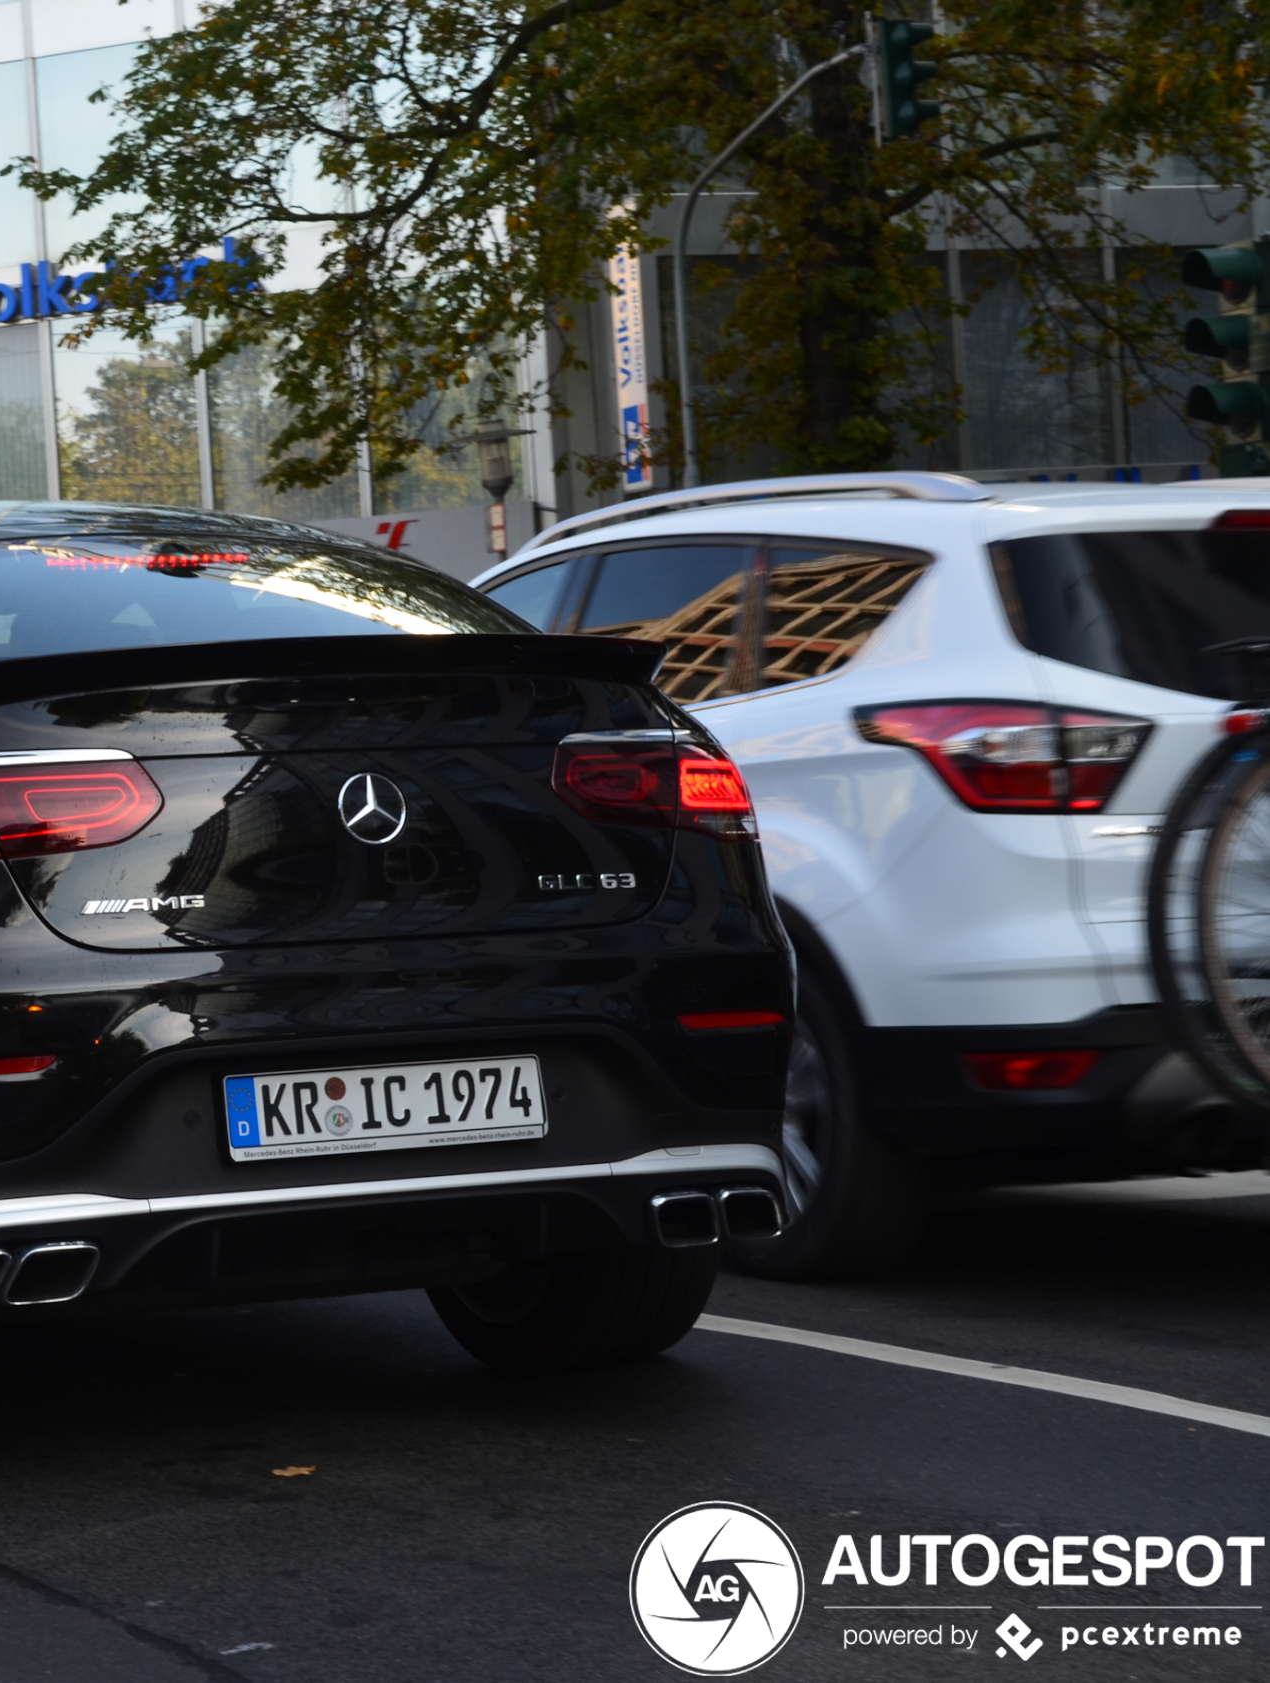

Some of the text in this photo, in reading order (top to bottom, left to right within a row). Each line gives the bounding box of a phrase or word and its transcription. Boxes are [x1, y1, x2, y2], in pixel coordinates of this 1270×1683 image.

[538, 872, 636, 890] GLC 63
[121, 894, 205, 912] AMG
[261, 1081, 322, 1137] KR
[360, 1075, 411, 1130] IC
[424, 1066, 532, 1125] 1974
[238, 1120, 250, 1137] D
[428, 1129, 535, 1144] www.mercedes-benz-rhein-ruhr.de
[243, 1148, 294, 1158] Mercedes-Benz
[295, 1145, 331, 1154] Rhein-Ruhr
[341, 1141, 377, 1151] Düsseldorf
